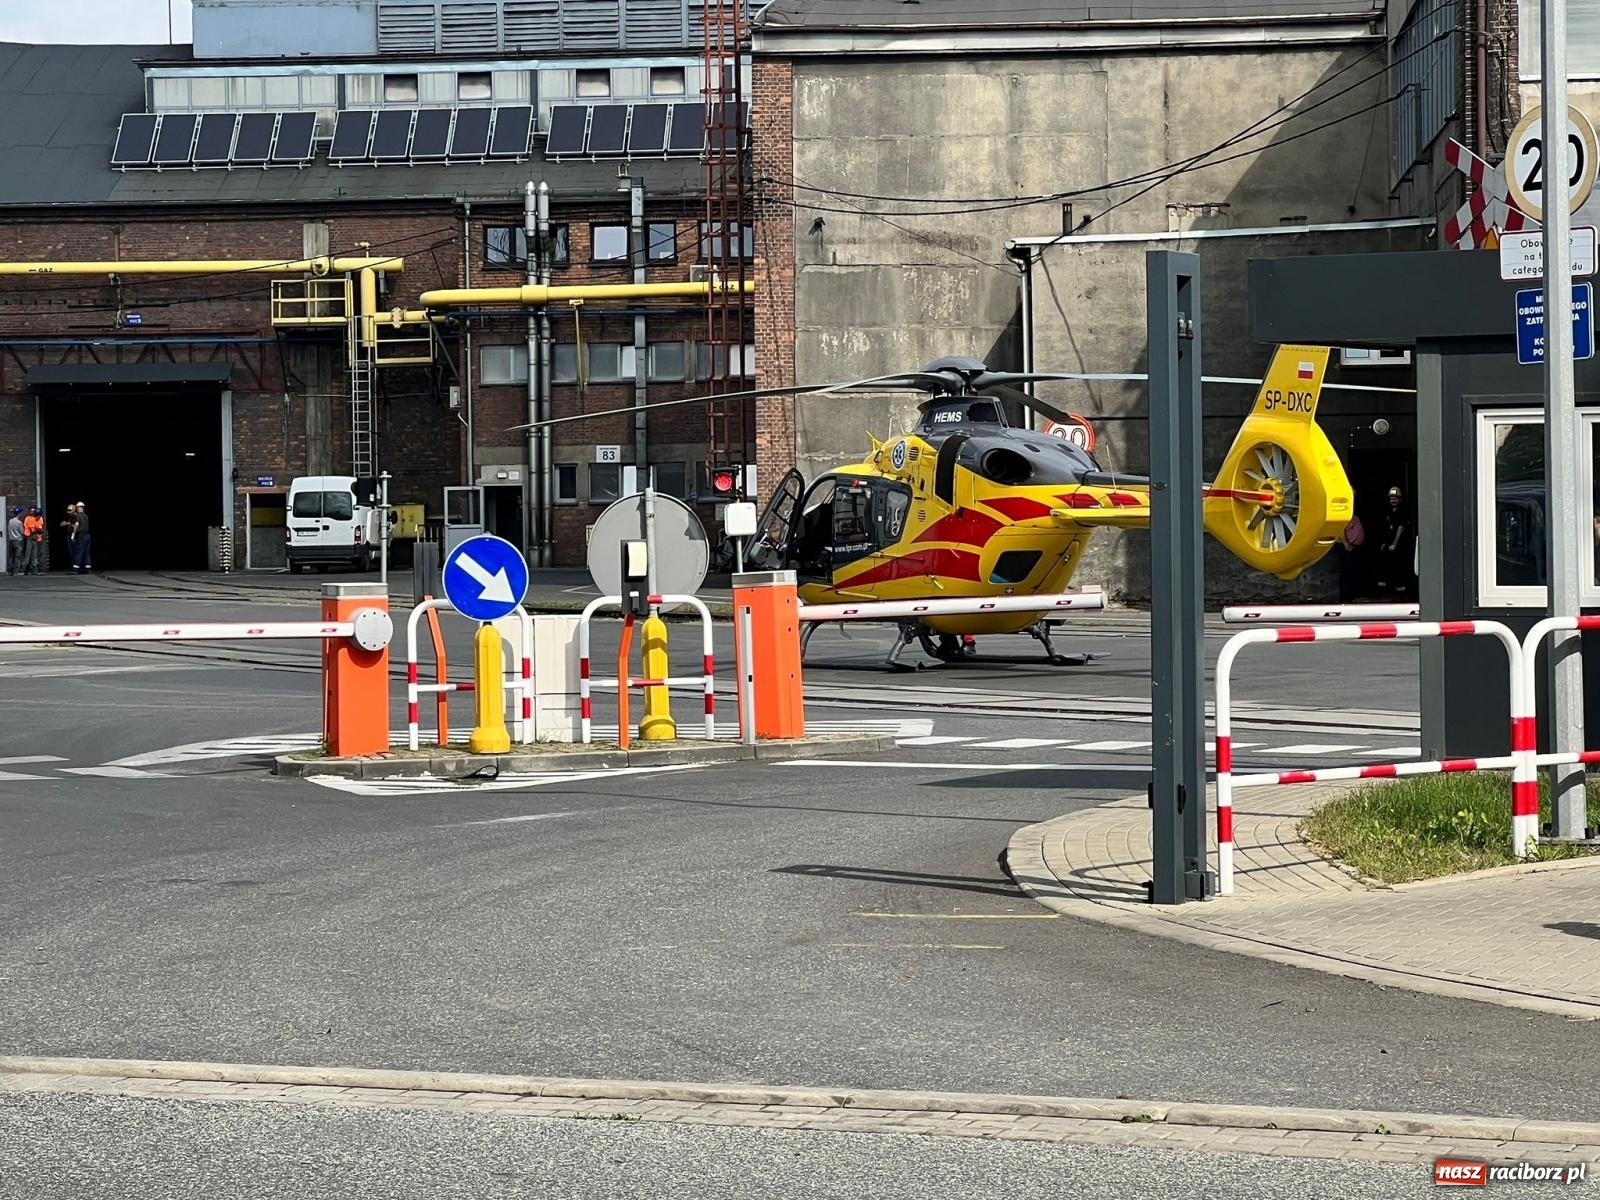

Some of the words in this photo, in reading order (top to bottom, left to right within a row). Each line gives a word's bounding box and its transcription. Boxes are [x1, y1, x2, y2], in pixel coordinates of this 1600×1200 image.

[1264, 389, 1313, 413] SP-DXC
[933, 410, 963, 424] HEMS
[602, 450, 615, 461] 83
